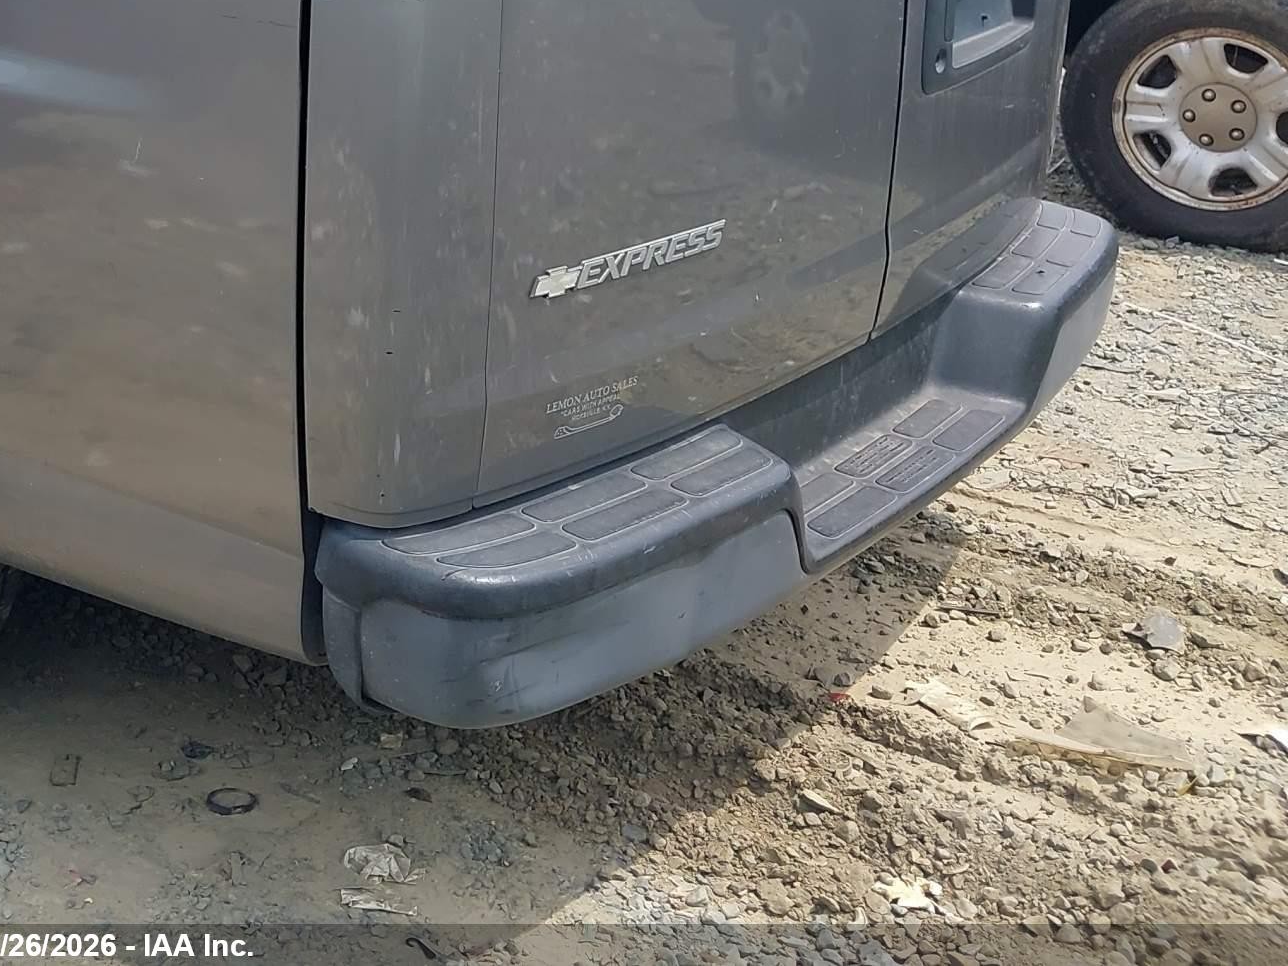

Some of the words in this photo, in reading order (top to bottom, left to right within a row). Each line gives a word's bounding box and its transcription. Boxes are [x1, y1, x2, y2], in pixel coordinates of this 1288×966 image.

[576, 219, 726, 290] EXPRESS
[546, 394, 582, 414] LEMON
[583, 386, 610, 403] AUTO
[611, 376, 638, 393] SALES
